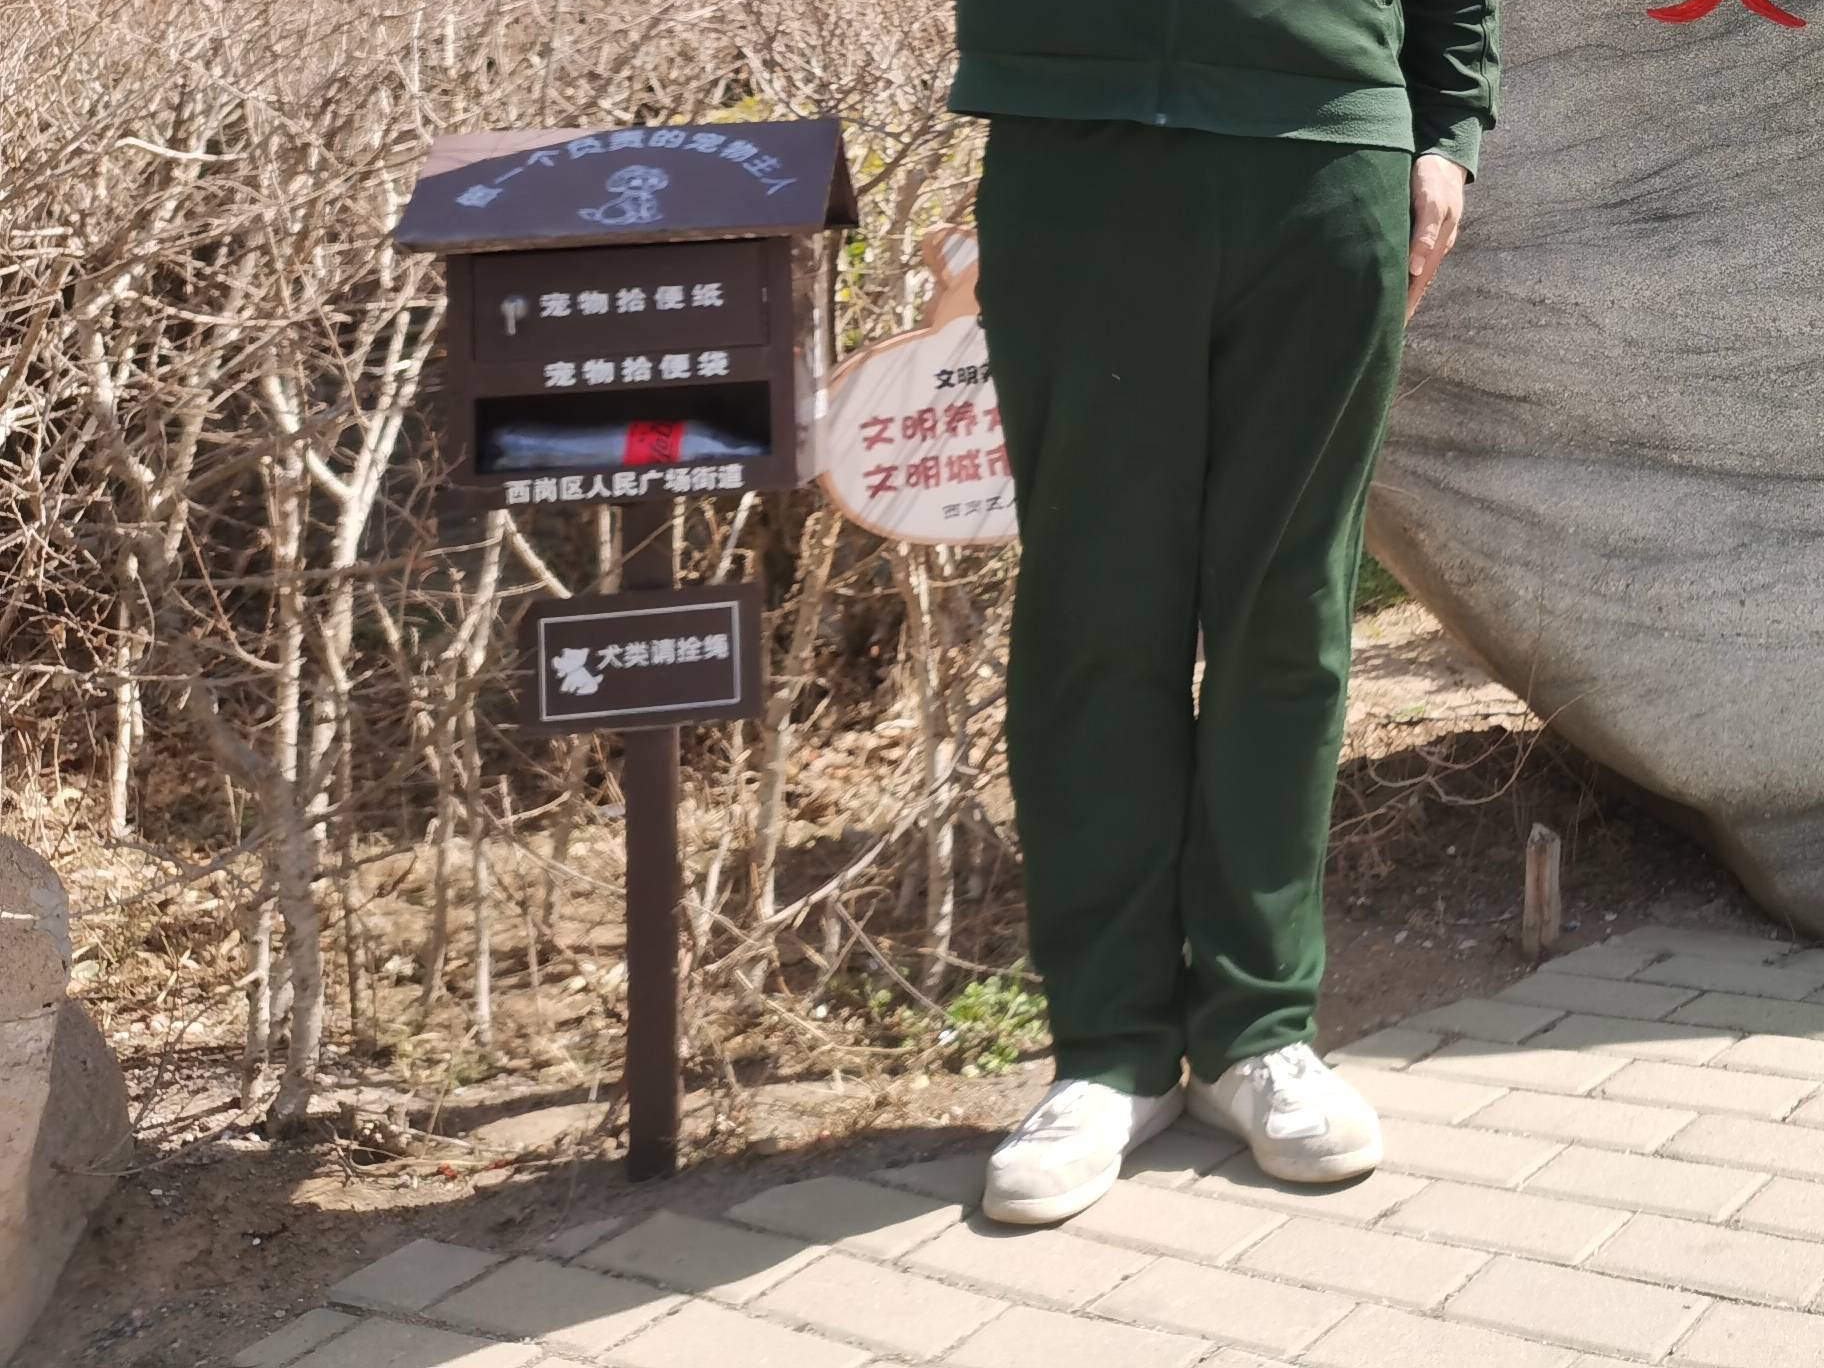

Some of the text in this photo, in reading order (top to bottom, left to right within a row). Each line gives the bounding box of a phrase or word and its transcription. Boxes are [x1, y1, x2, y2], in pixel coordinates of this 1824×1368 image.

[503, 463, 745, 505] 西岗区人民广场街道
